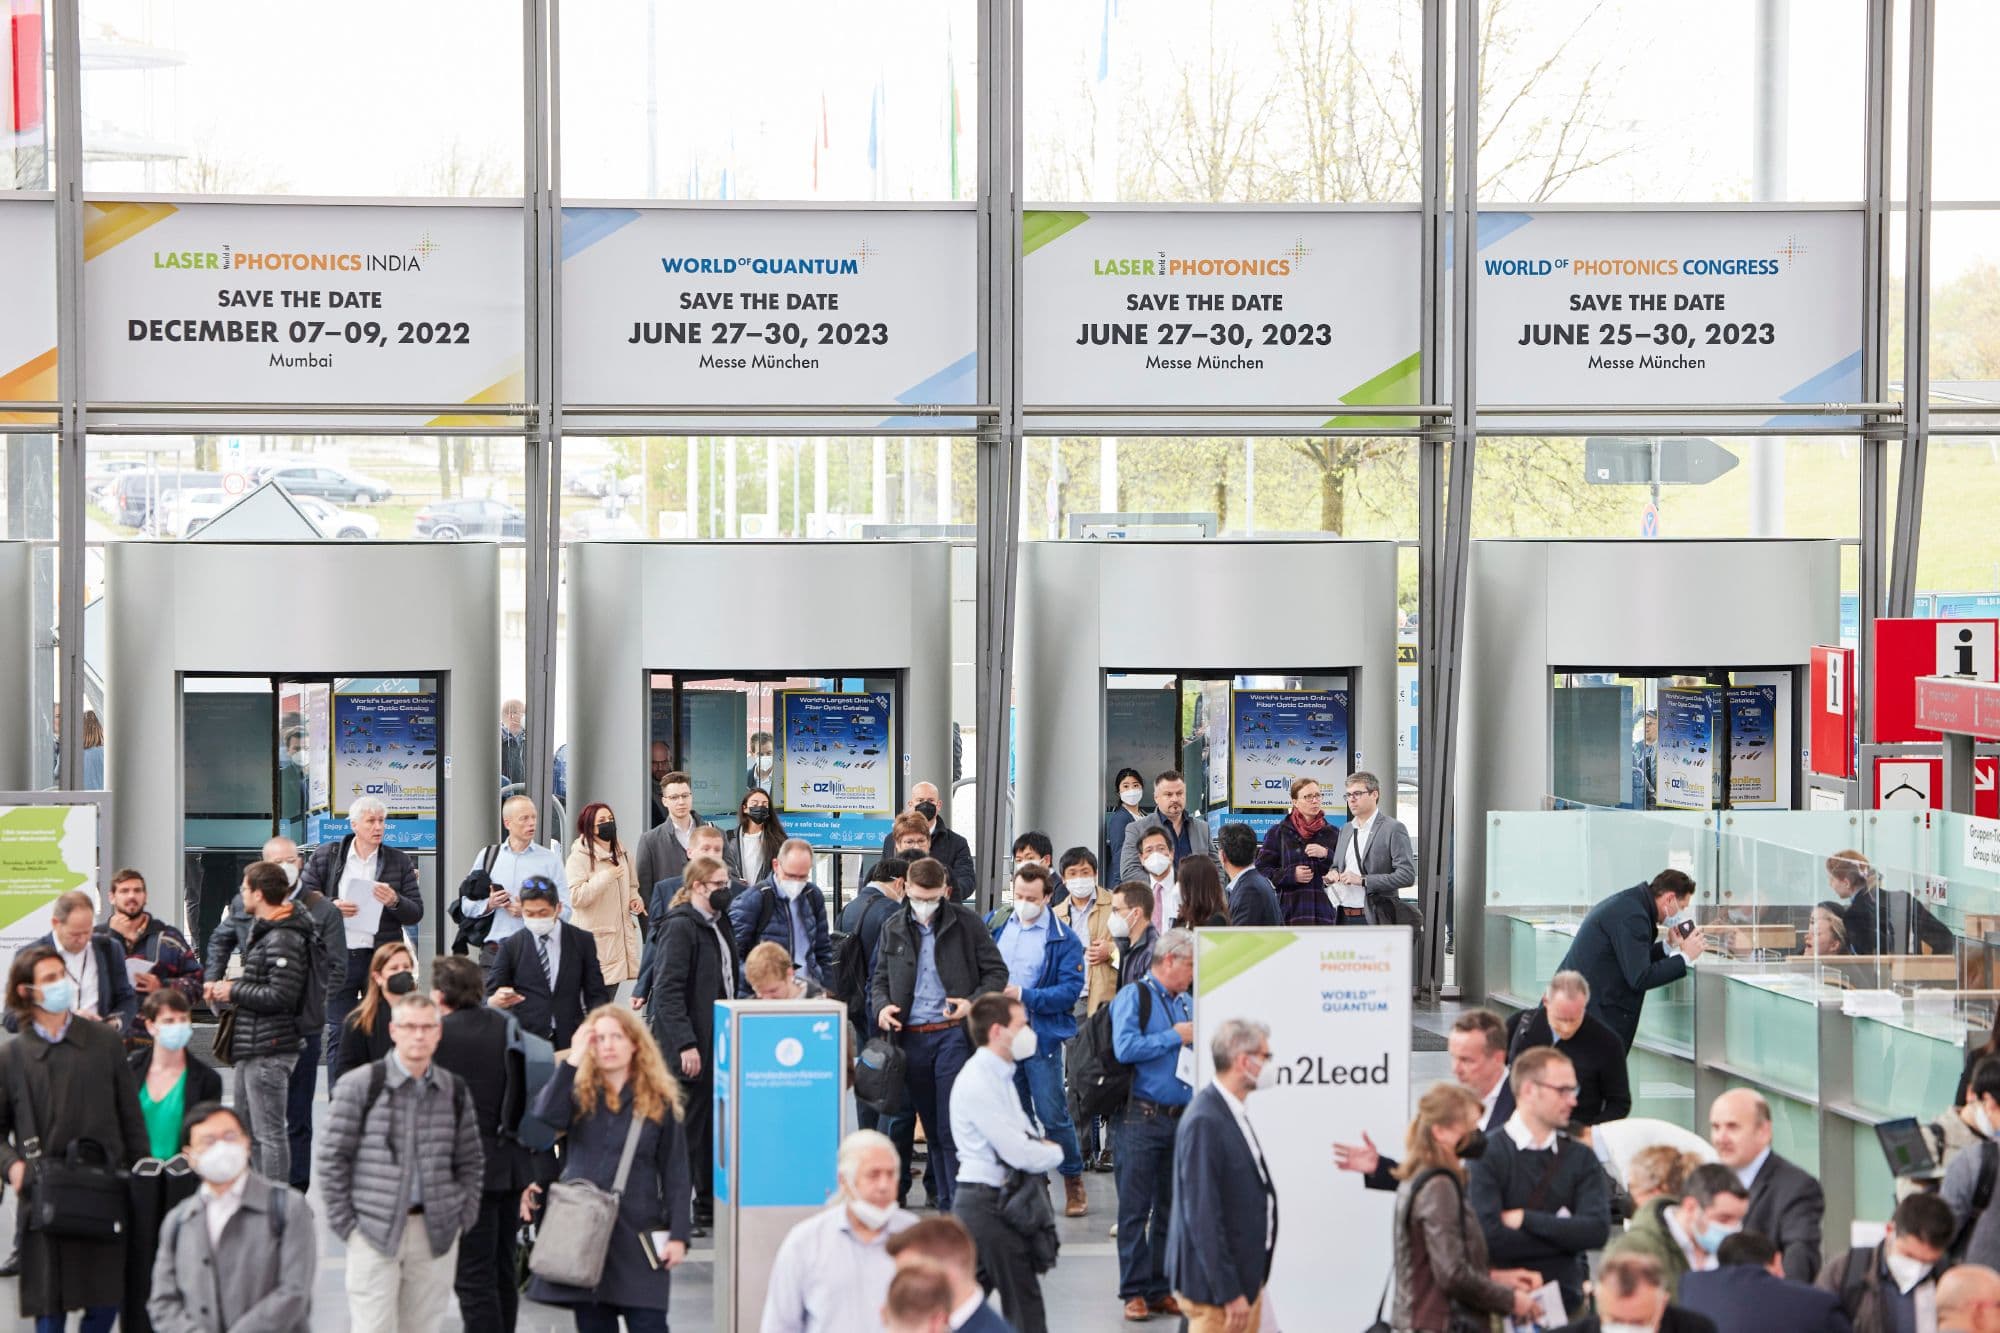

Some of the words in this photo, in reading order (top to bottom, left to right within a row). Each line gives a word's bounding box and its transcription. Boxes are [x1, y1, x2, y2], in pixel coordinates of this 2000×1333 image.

[154, 251, 219, 270] LASER
[234, 252, 362, 272] PHOTONICS
[367, 254, 421, 272] INDIA
[661, 257, 737, 274] WORLD
[752, 258, 859, 275] QUANTUM
[1094, 258, 1155, 276] LASER
[1169, 258, 1291, 277] PHOTONICS
[1484, 259, 1552, 276] WORLD
[1554, 258, 1570, 269] OF
[1573, 259, 1679, 276] PHOTONICS
[1683, 258, 1779, 276] CONGRESS
[218, 289, 274, 308] SAVE
[280, 290, 322, 309] THE
[328, 290, 383, 309] DATE
[679, 291, 734, 310] SAVE
[740, 292, 780, 311] THE
[786, 292, 839, 311] DATE
[1126, 293, 1180, 312] SAVE
[1185, 293, 1225, 312] THE
[1231, 293, 1283, 312] DATE
[1569, 293, 1623, 312] SAVE
[1628, 293, 1668, 312] THE
[1673, 293, 1726, 311] DATE
[127, 319, 280, 343] DECEMBER
[397, 321, 470, 345] 2022
[628, 321, 702, 345] JUNE
[817, 322, 889, 346] 2023
[1075, 323, 1149, 346] JUNE
[1261, 323, 1332, 346] 2023
[1517, 323, 1590, 346] JUNE
[1704, 322, 1776, 346] 2023
[269, 352, 333, 368] Mumbai
[698, 354, 747, 369] Messe
[751, 353, 819, 369] München
[1145, 354, 1193, 370] Messe
[1197, 353, 1264, 370] München
[1587, 354, 1635, 370] Messe
[1638, 353, 1706, 370] München
[366, 784, 384, 794] OZ
[813, 783, 829, 793] OZ
[1264, 779, 1282, 789] OZ
[1320, 961, 1391, 972] PHOTONICS
[1321, 990, 1368, 1000] WORLD
[1322, 1002, 1389, 1013] QUANTUM
[1276, 1052, 1390, 1086] n2Lead
